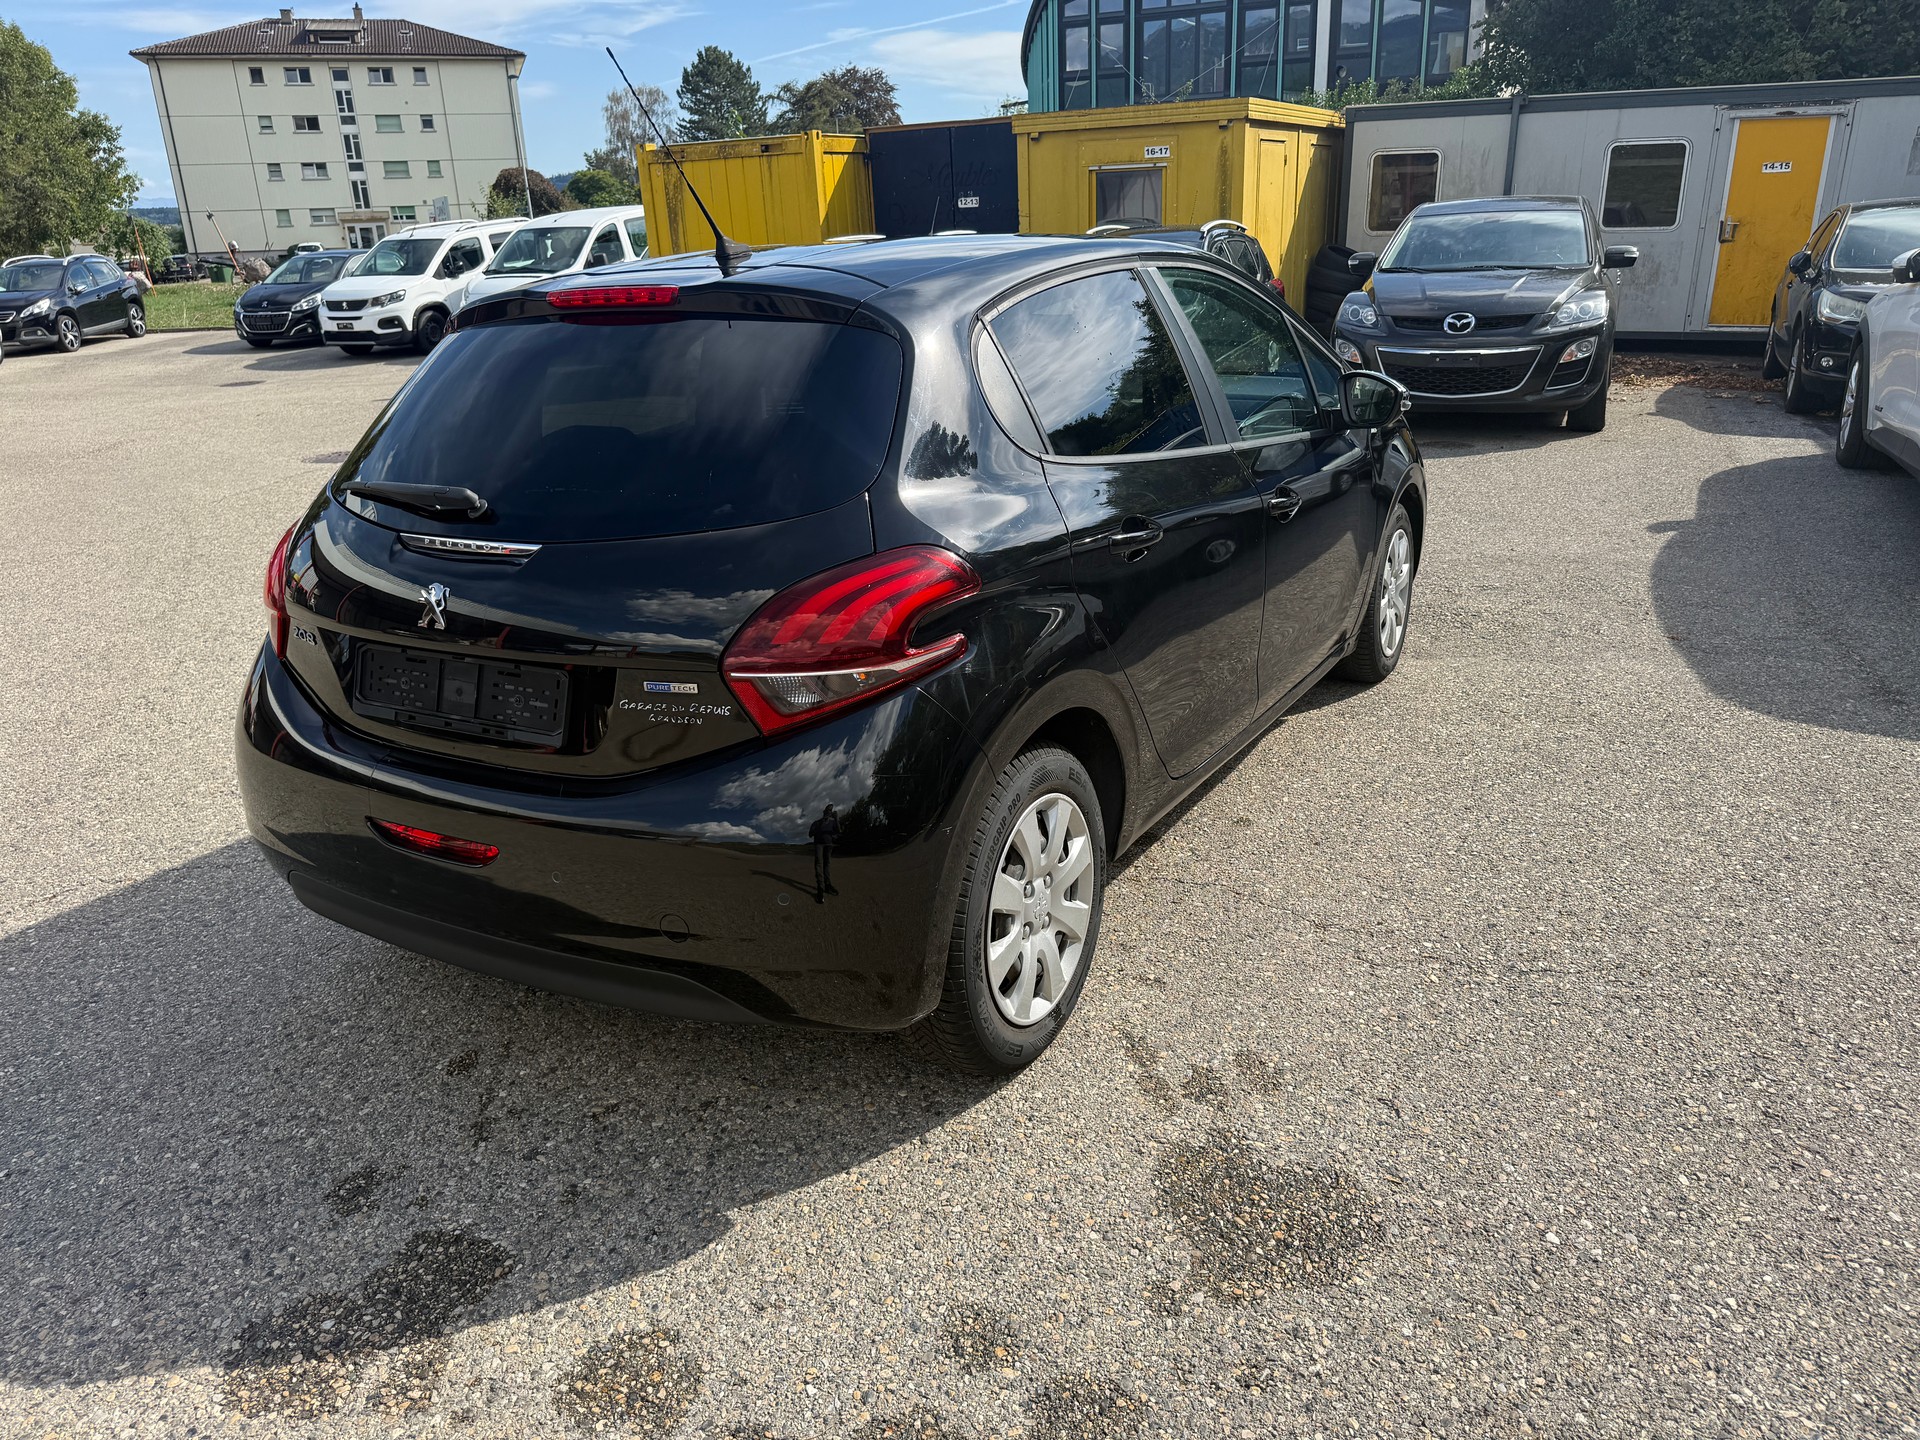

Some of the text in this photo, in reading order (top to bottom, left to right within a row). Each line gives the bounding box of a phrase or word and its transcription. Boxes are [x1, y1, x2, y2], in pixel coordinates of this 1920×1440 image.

[1145, 147, 1169, 156] 16-17
[1763, 162, 1791, 171] 14-15
[959, 198, 979, 206] 12-13
[424, 538, 505, 553] PEUGEOT
[293, 625, 317, 646] 208
[619, 699, 668, 712] GARAGE
[980, 792, 1021, 889] SUPERGRIP PRO
